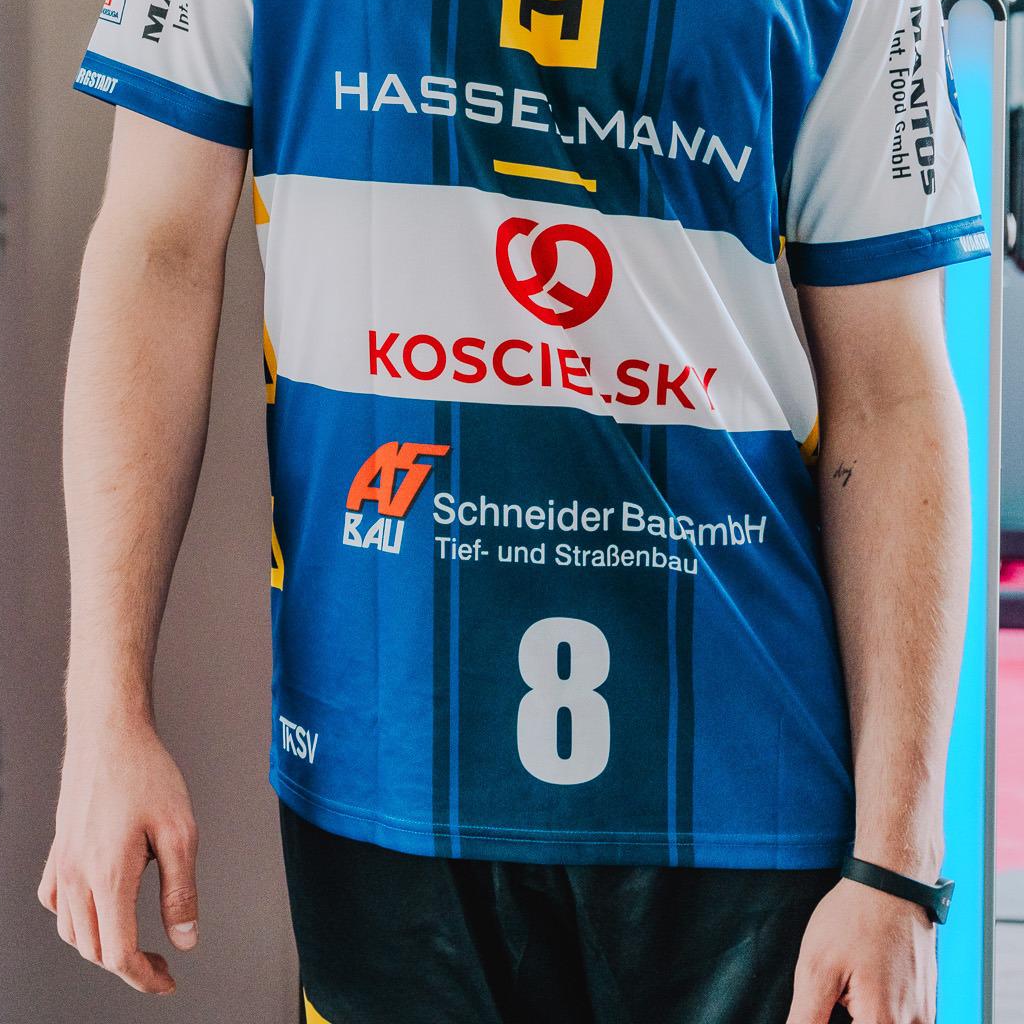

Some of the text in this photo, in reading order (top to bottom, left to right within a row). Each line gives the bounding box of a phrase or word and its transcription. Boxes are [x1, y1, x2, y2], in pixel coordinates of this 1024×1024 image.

[172, 2, 189, 32] Int.
[909, 5, 936, 196] MANTOS
[342, 511, 405, 555] BAU
[432, 492, 767, 546] Schneider Bau GmbH
[434, 536, 698, 575] Tief- und Straßenbau
[517, 617, 611, 785] 8
[279, 715, 318, 764] TKSV
